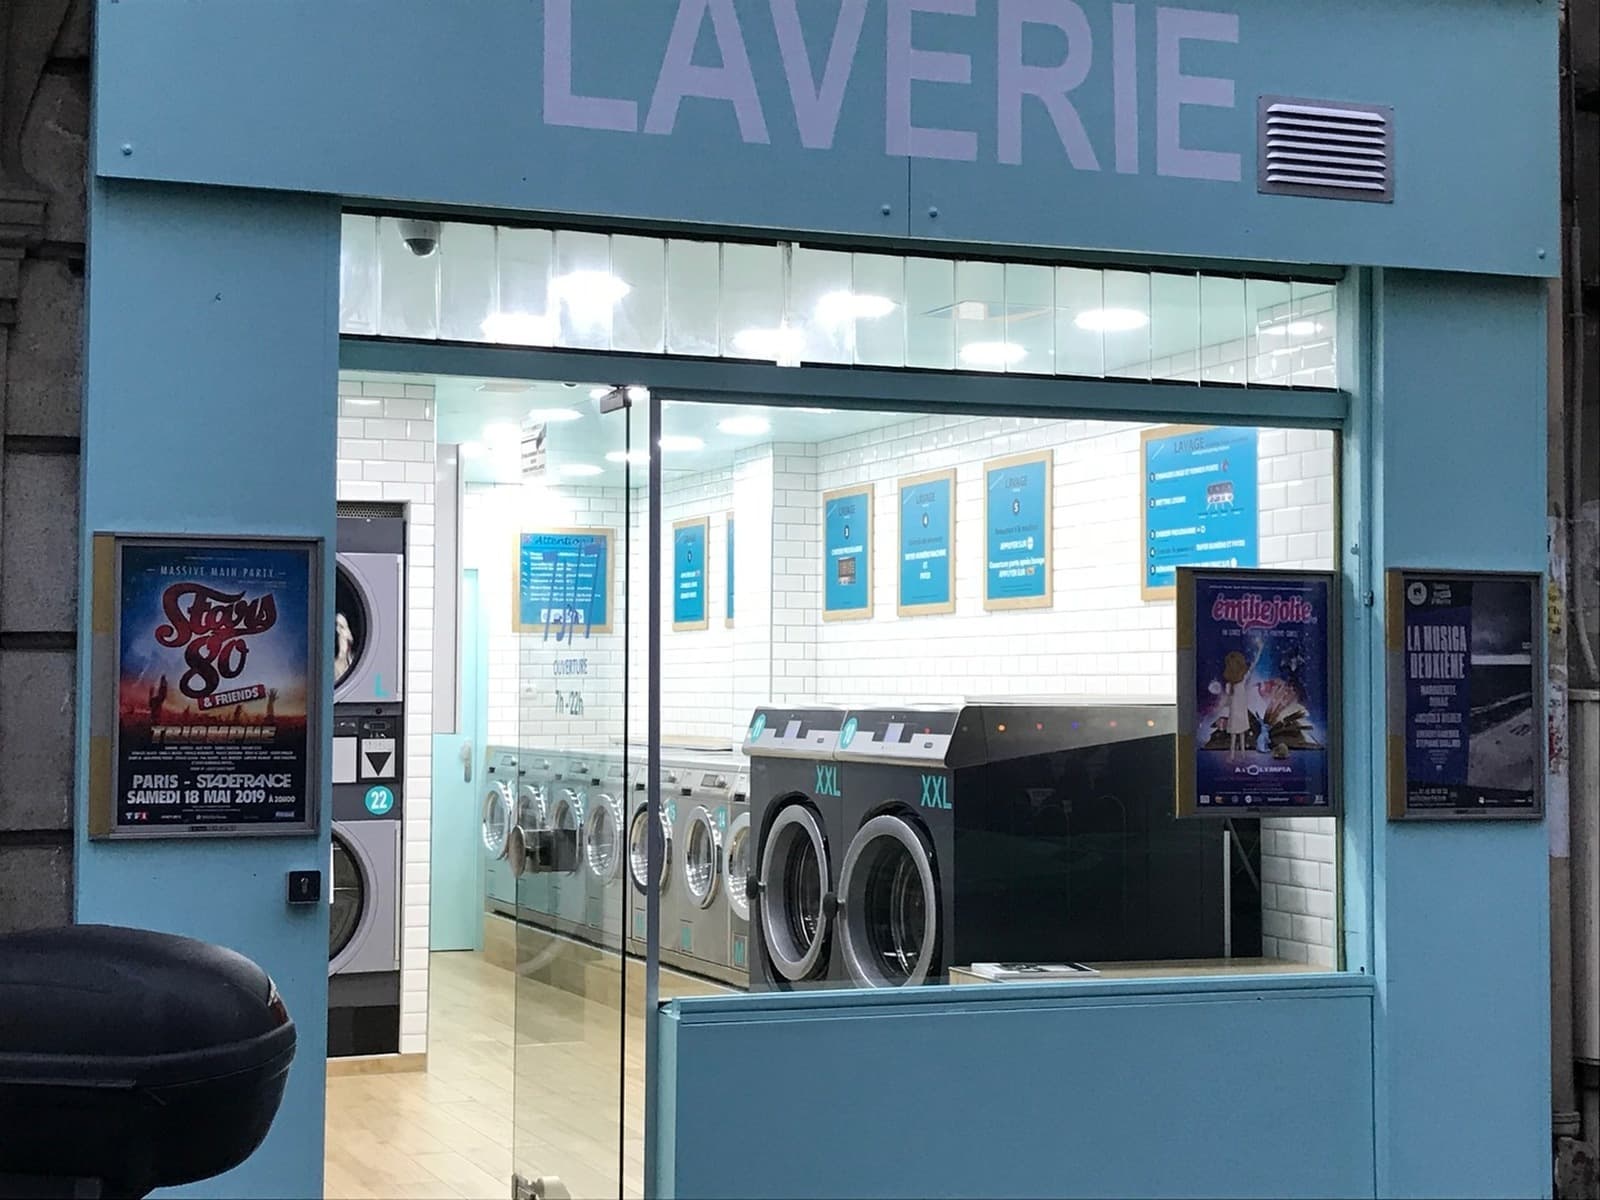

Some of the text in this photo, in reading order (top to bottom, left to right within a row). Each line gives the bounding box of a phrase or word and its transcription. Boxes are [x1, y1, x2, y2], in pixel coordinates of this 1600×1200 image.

[543, 0, 1241, 182] LAVERIE
[160, 565, 274, 578] MASSIVE MAIN PARTY
[155, 581, 278, 648] Stars
[1407, 625, 1421, 652] LA
[179, 634, 249, 699] 80
[553, 659, 588, 675] OUVERTURE
[374, 673, 389, 697] L
[203, 687, 260, 708] & FRIENDS
[133, 775, 179, 789] PARIS
[815, 765, 841, 797] XXL
[920, 774, 952, 809] XXL
[127, 790, 181, 804] SAMEDI
[184, 790, 200, 804] 18
[204, 790, 231, 804] MAI
[235, 789, 266, 804] 2019
[370, 790, 388, 810] 22
[125, 812, 148, 821] TF1
